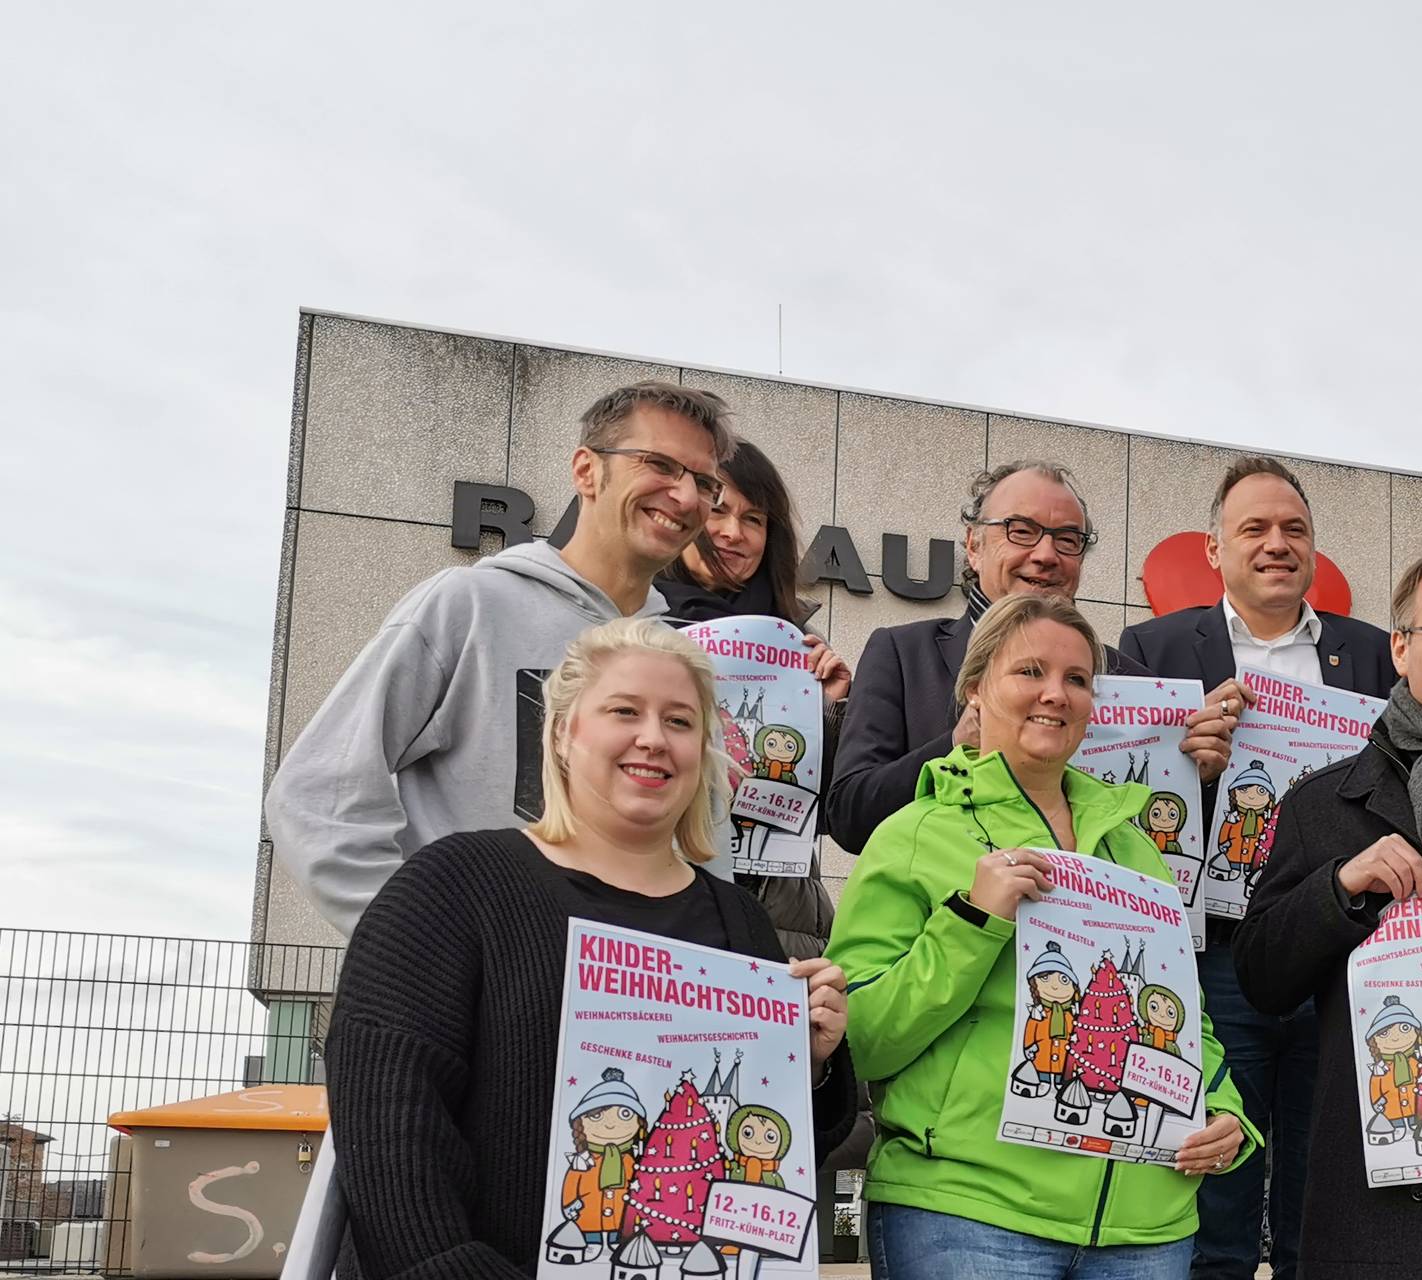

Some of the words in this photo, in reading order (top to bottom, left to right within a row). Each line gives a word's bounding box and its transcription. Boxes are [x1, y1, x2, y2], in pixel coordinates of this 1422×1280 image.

[1243, 671, 1310, 704] KINDER-
[742, 785, 804, 814] 12.-16.12.
[1043, 868, 1183, 928] EIHNACHTSDORF
[1028, 917, 1066, 937] GESCHENKE
[1067, 931, 1096, 947] BASTELN
[580, 934, 683, 975] KINDER-
[578, 963, 800, 1026] WEIHNACHTSDORF
[1363, 980, 1404, 988] GESCHENKE
[575, 1010, 673, 1022] WEIHNACHTSBÄCKEREI
[657, 1031, 759, 1044] WEIHNACHTSGESCHICHTEN
[580, 1041, 633, 1061] GESCHENKE
[635, 1053, 673, 1069] BASTELN
[1127, 1071, 1190, 1104] FRITZ-KÜHN-PLATZ
[1131, 1053, 1193, 1092] 12.-16.12.
[714, 1193, 801, 1229] 12.-16.12.
[709, 1215, 796, 1244] FRITZ-KÜHN-PLATZ
